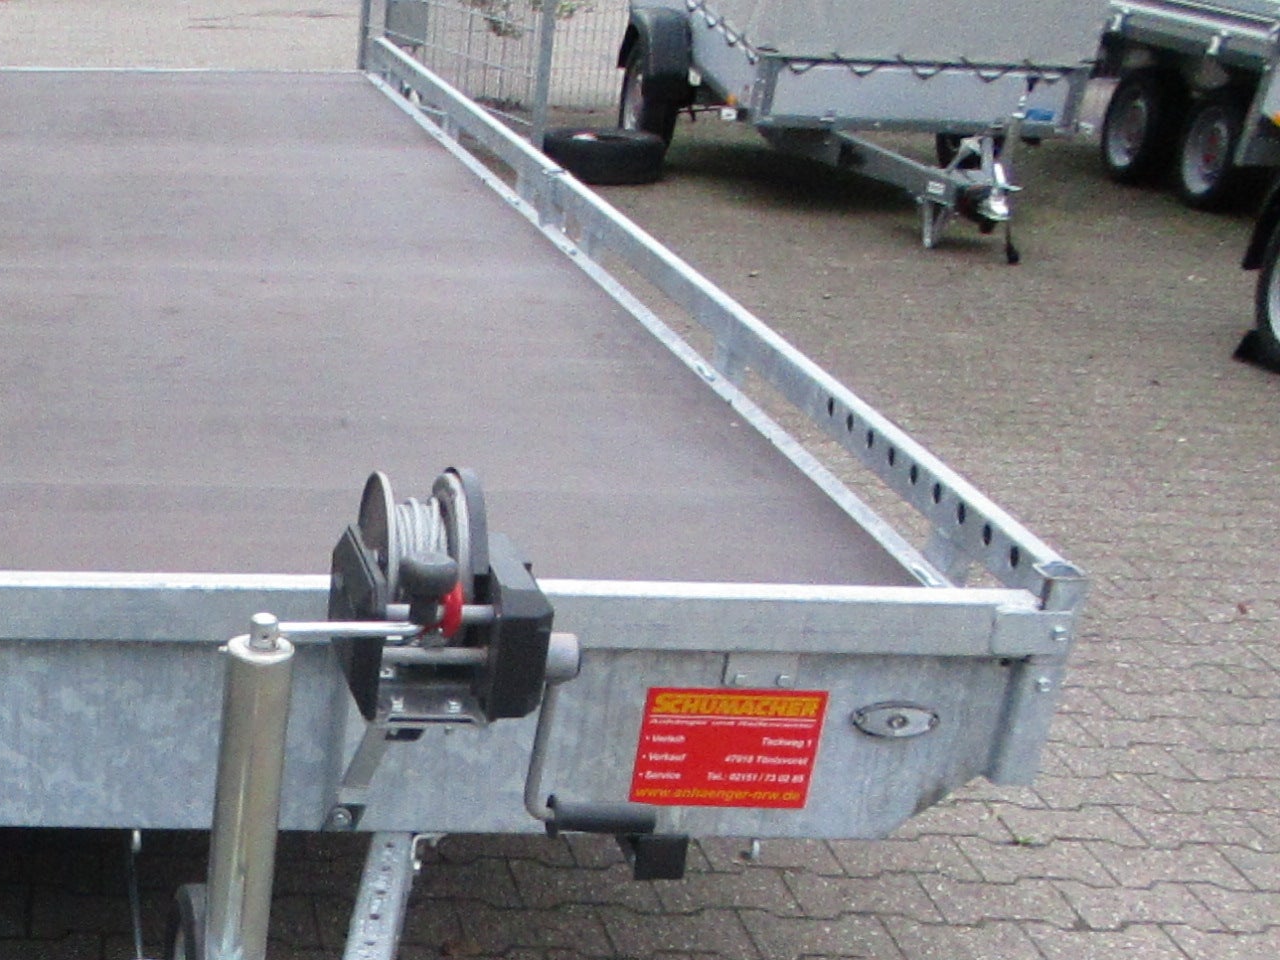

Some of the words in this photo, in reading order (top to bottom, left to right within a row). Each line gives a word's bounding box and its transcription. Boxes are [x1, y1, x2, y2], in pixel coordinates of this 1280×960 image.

[652, 693, 821, 716] SCHUMACHER
[648, 752, 687, 762] Verkauf
[644, 770, 682, 780] Service
